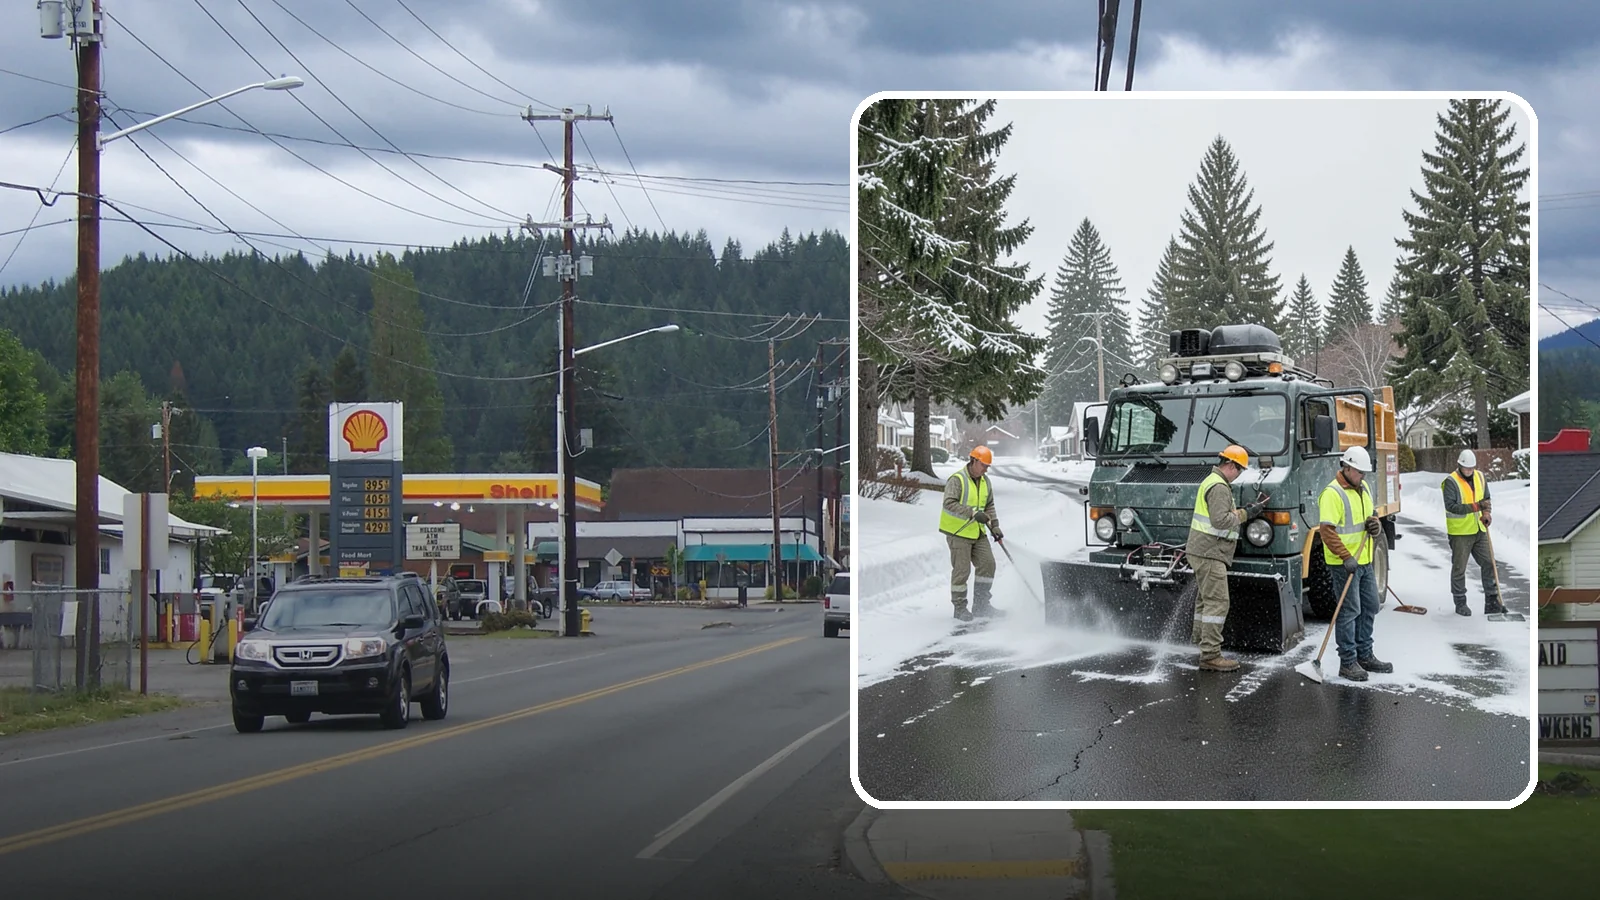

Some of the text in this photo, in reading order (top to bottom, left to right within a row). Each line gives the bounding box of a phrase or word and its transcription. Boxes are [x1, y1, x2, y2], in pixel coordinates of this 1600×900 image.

[365, 480, 384, 490] 395
[490, 484, 548, 499] Shell
[365, 494, 384, 504] 405
[365, 507, 384, 518] 415
[366, 522, 384, 532] 429
